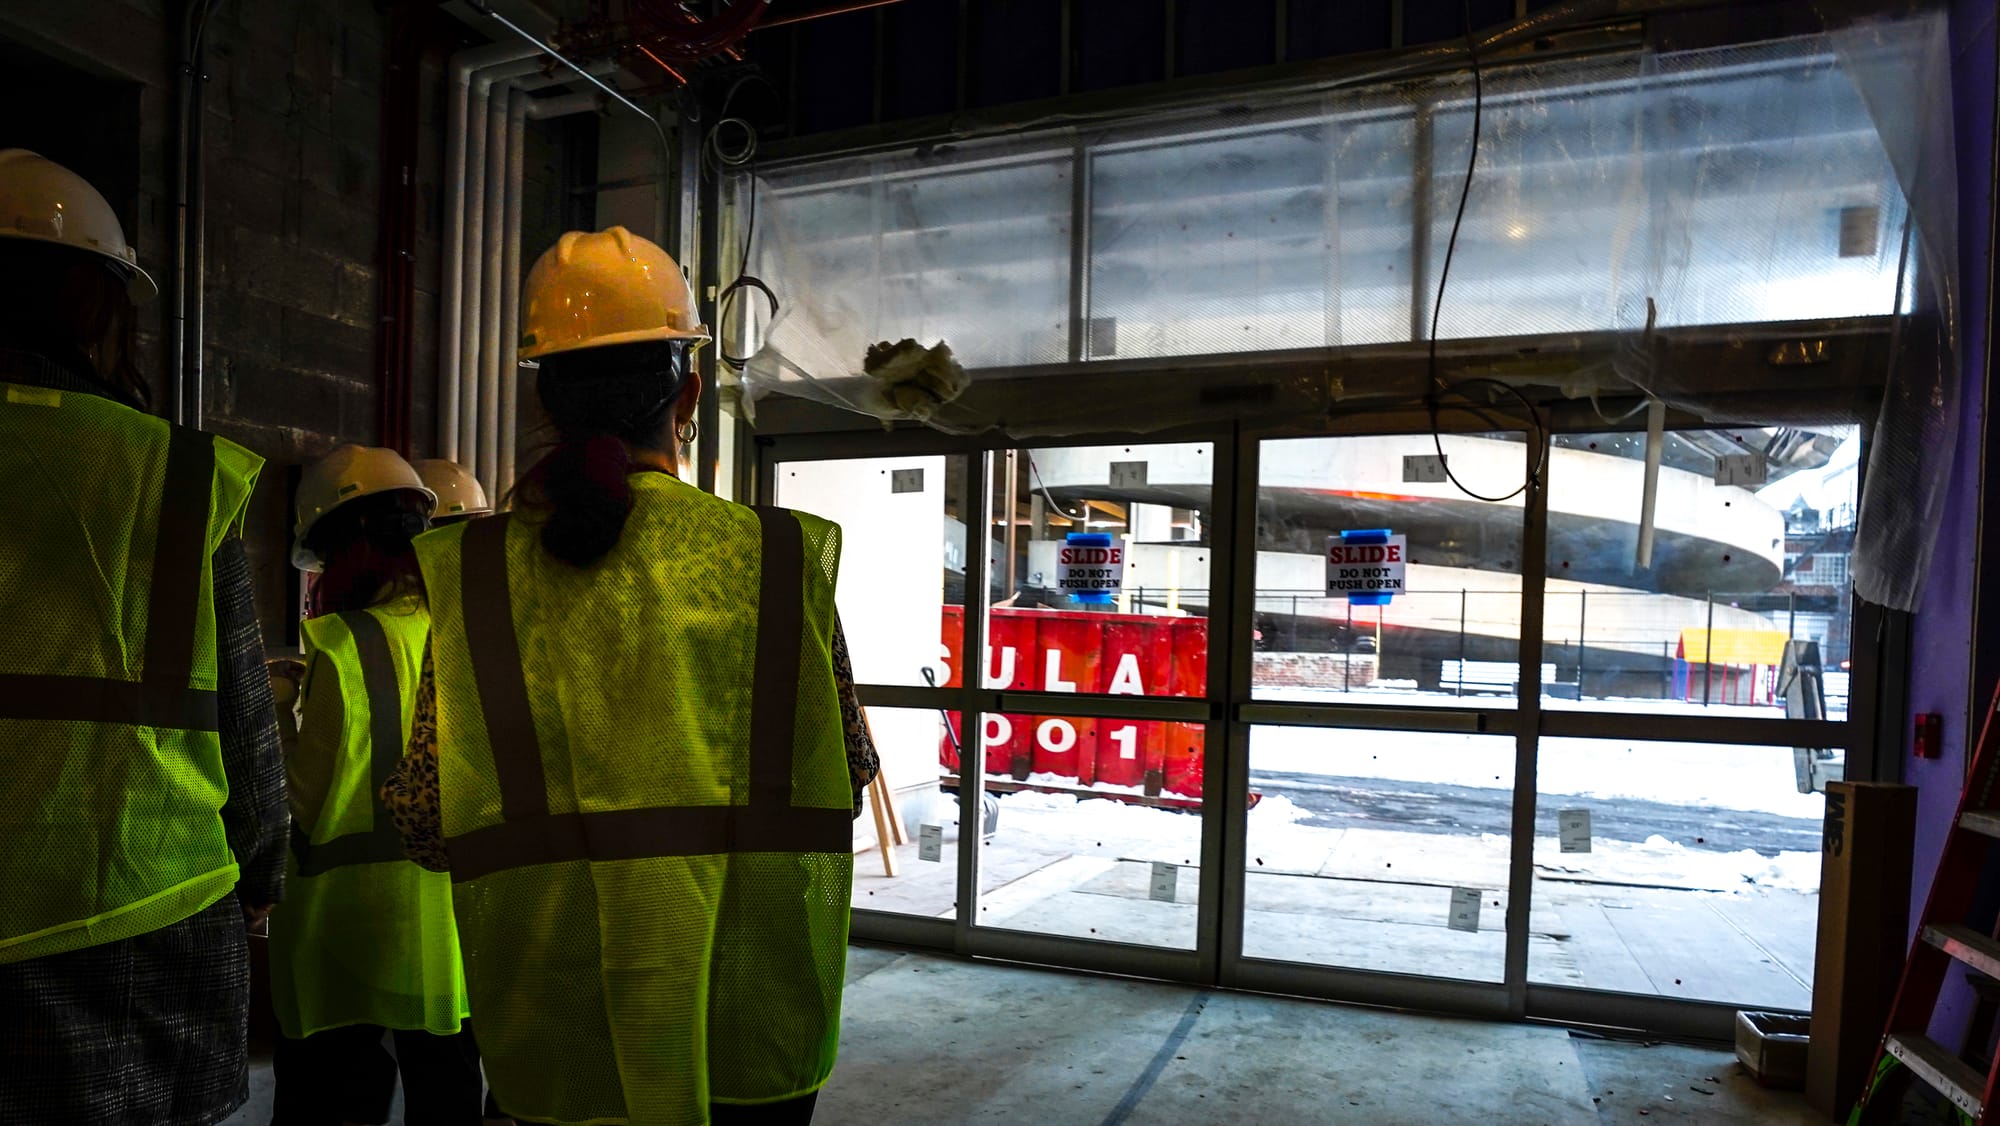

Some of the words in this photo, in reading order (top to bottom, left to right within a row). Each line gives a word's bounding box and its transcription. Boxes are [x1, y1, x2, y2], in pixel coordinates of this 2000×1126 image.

[1061, 548, 1121, 565] SLIDE
[1330, 545, 1401, 564] SLIDE
[1068, 568, 1085, 578] DO
[1088, 568, 1112, 578] NOT
[1339, 567, 1359, 579] DO
[1362, 567, 1391, 578] NOT
[1059, 579, 1089, 589] PUSH
[1091, 579, 1120, 589] OPEN
[1329, 580, 1363, 590] PUSH
[1367, 579, 1401, 589] OPEN
[1825, 793, 1845, 857] 3M
